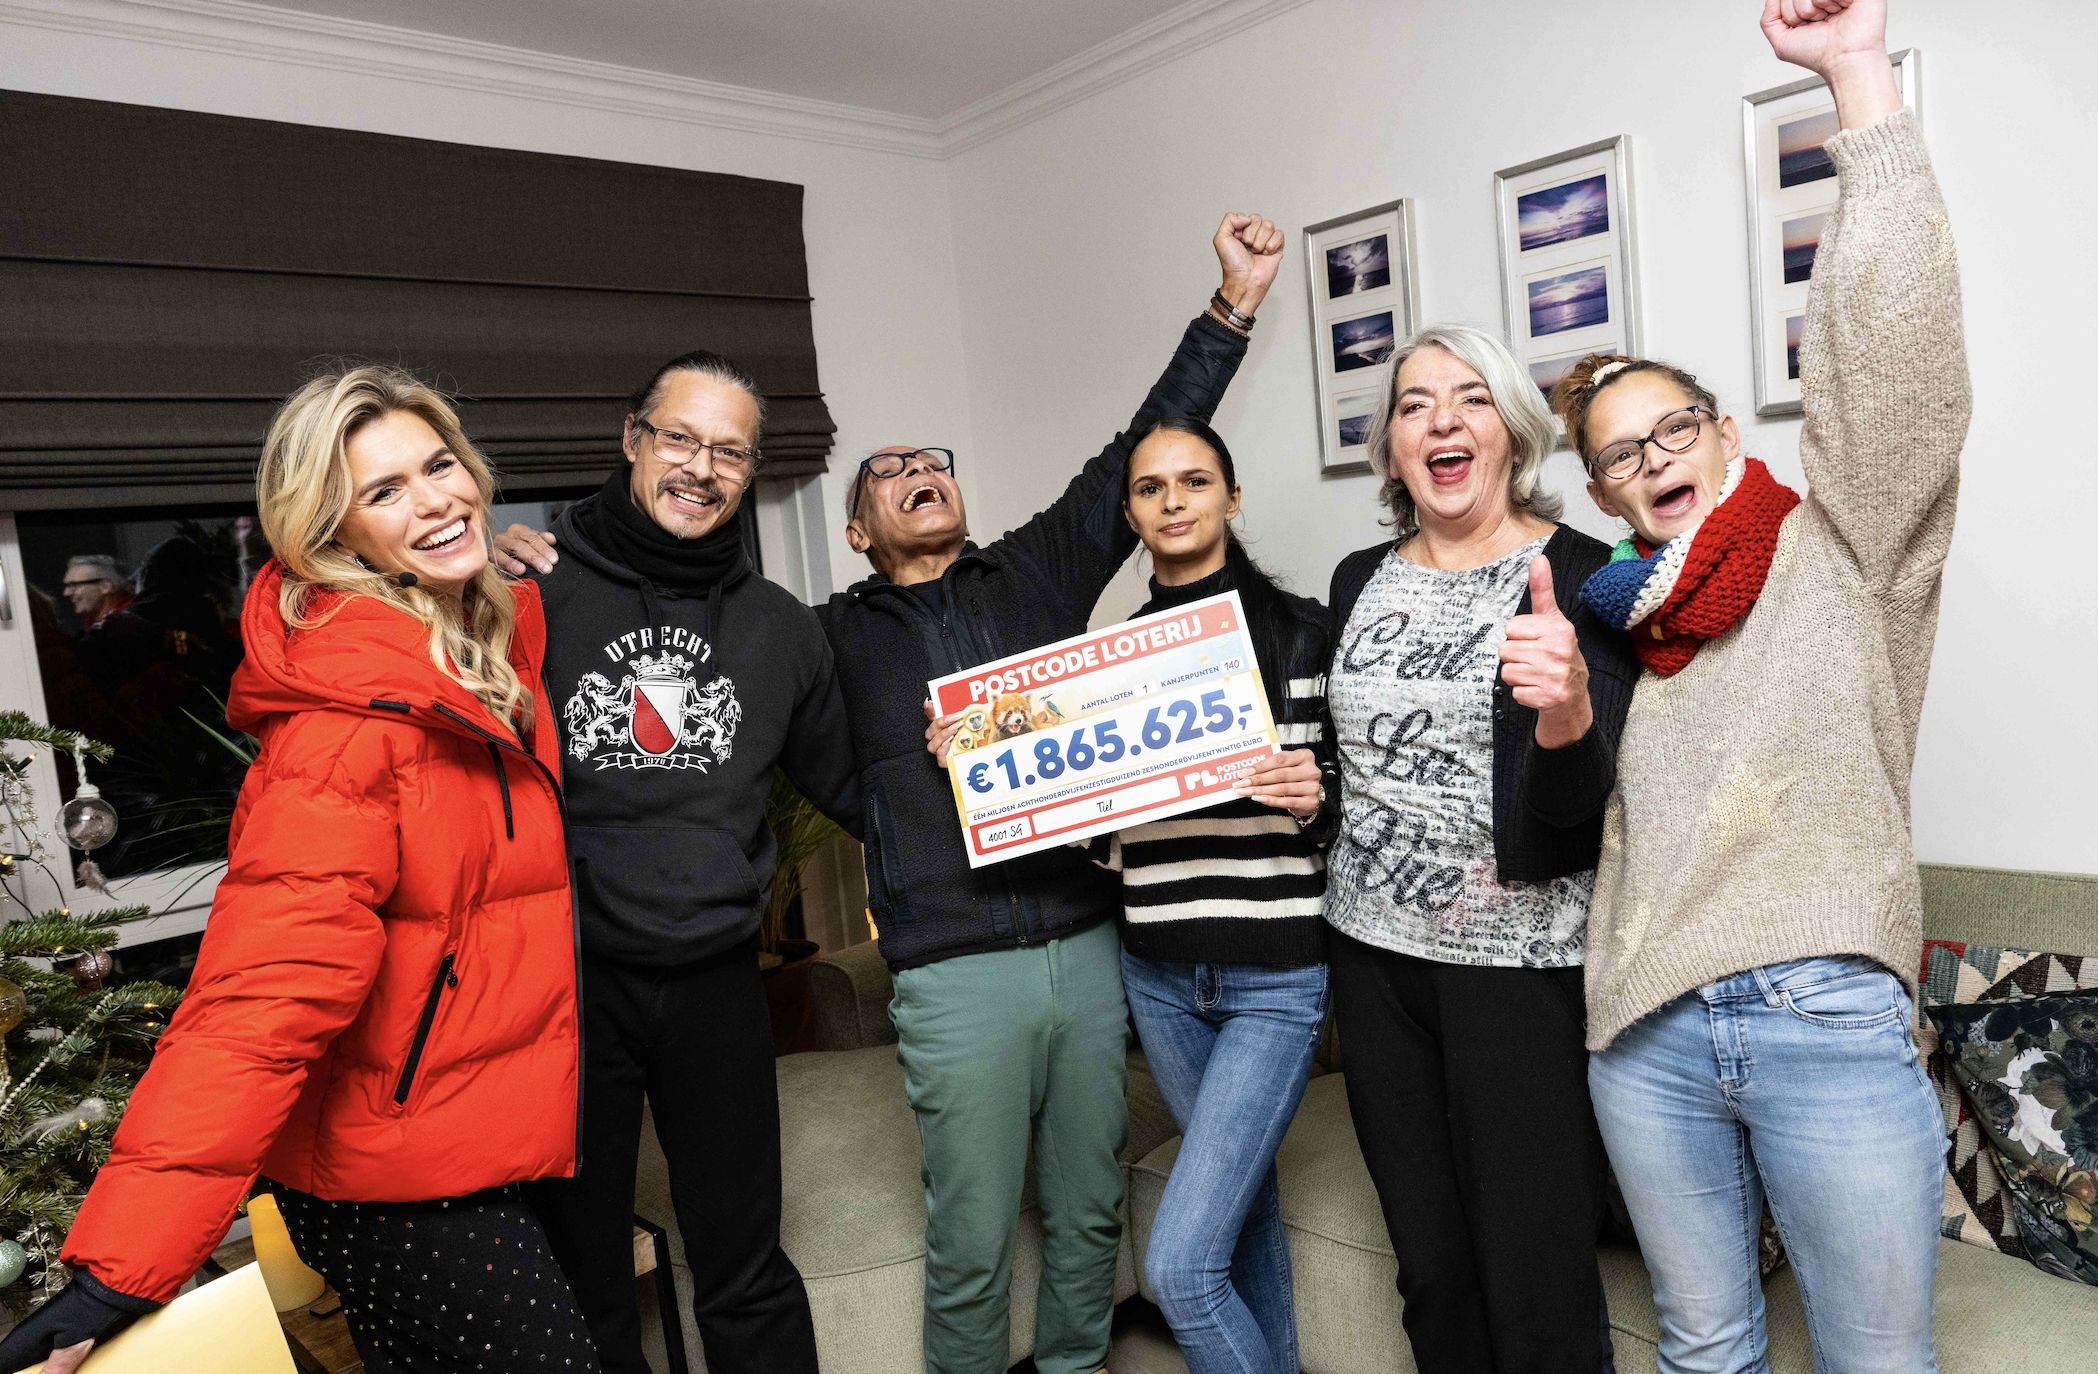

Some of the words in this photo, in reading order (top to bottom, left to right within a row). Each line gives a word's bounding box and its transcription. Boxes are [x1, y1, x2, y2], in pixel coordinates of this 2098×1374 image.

[603, 626, 711, 664] UTRECHT
[968, 645, 1099, 702] POSTCODE
[1100, 614, 1203, 663] LOTERIJ
[1081, 697, 1109, 710] AANTAL
[1111, 690, 1134, 702] LOTEN
[1142, 685, 1148, 694] 1
[1160, 666, 1219, 688] KANJERPUNTEN
[1223, 659, 1240, 671] 140
[973, 812, 986, 821] ÉÉN
[987, 804, 1016, 817] MILJOEN
[1017, 769, 1141, 809] ACHTHONDERDVIJFENZESTIGDUIZEND
[1142, 743, 1242, 774] ZESHONDERDVIJFENTWINTIG
[1243, 737, 1263, 747] EURO
[1216, 754, 1266, 774] POSTCODE
[1096, 799, 1114, 813] Tiel
[988, 830, 1008, 843] 4001
[1010, 823, 1023, 838] SG
